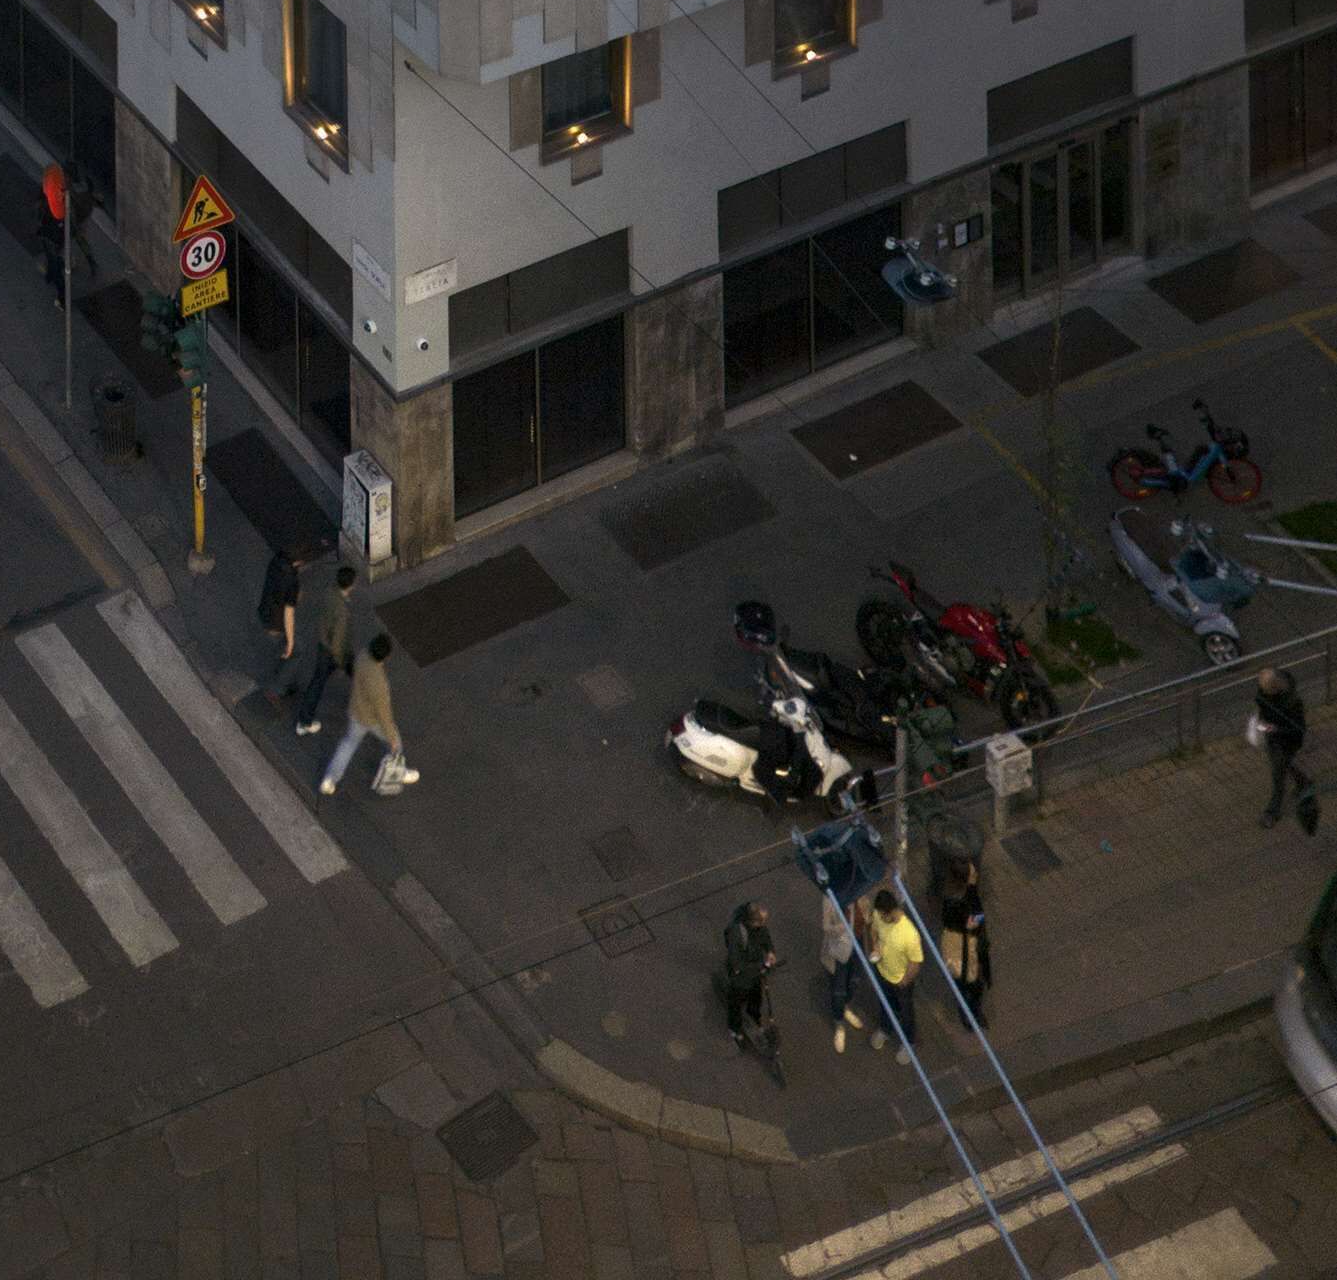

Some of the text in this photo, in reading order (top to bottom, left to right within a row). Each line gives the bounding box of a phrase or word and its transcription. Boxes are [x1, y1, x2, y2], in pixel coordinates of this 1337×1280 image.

[191, 241, 216, 268] 30
[192, 277, 218, 294] INIZIO
[194, 286, 216, 300] AREA
[184, 290, 227, 313] CANTIERE
